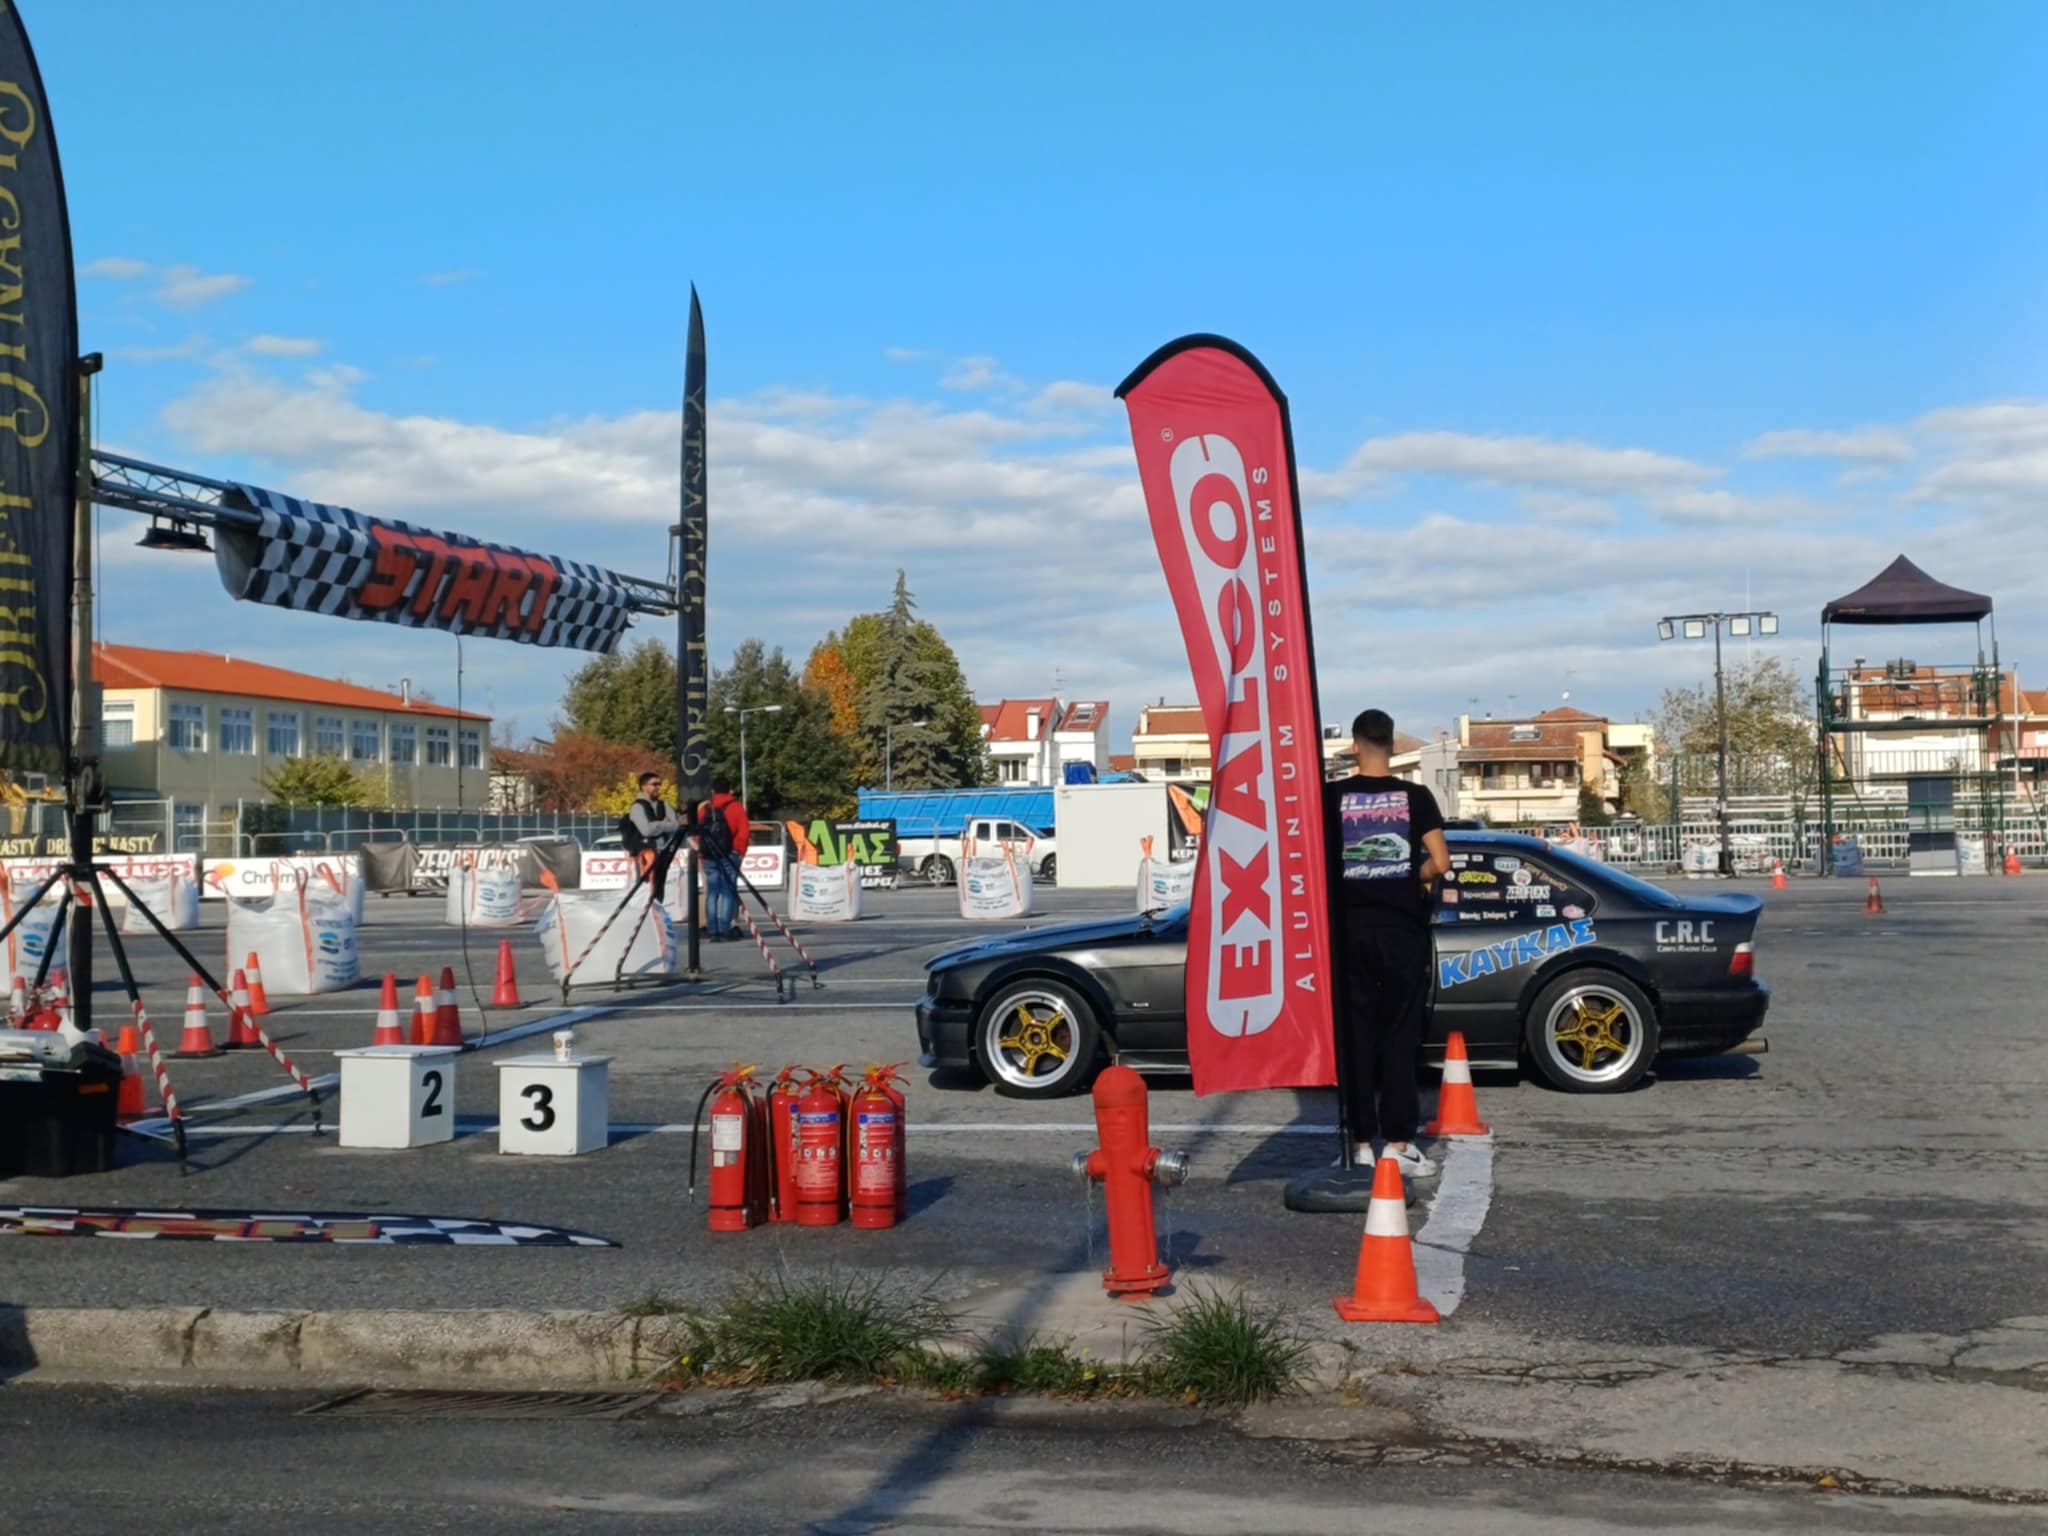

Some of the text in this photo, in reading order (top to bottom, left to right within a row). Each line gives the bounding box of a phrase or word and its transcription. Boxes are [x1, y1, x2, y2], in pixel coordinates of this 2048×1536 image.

[358, 524, 560, 632] START
[1189, 472, 1273, 1000] EXALCO
[1252, 466, 1316, 992] ALUMINIUM SYSTEMS
[1439, 917, 1597, 989] ΚΑΥΚΑΣ
[1656, 920, 1715, 943] C.R.C
[421, 1070, 442, 1118] 2
[520, 1084, 555, 1132] 3
